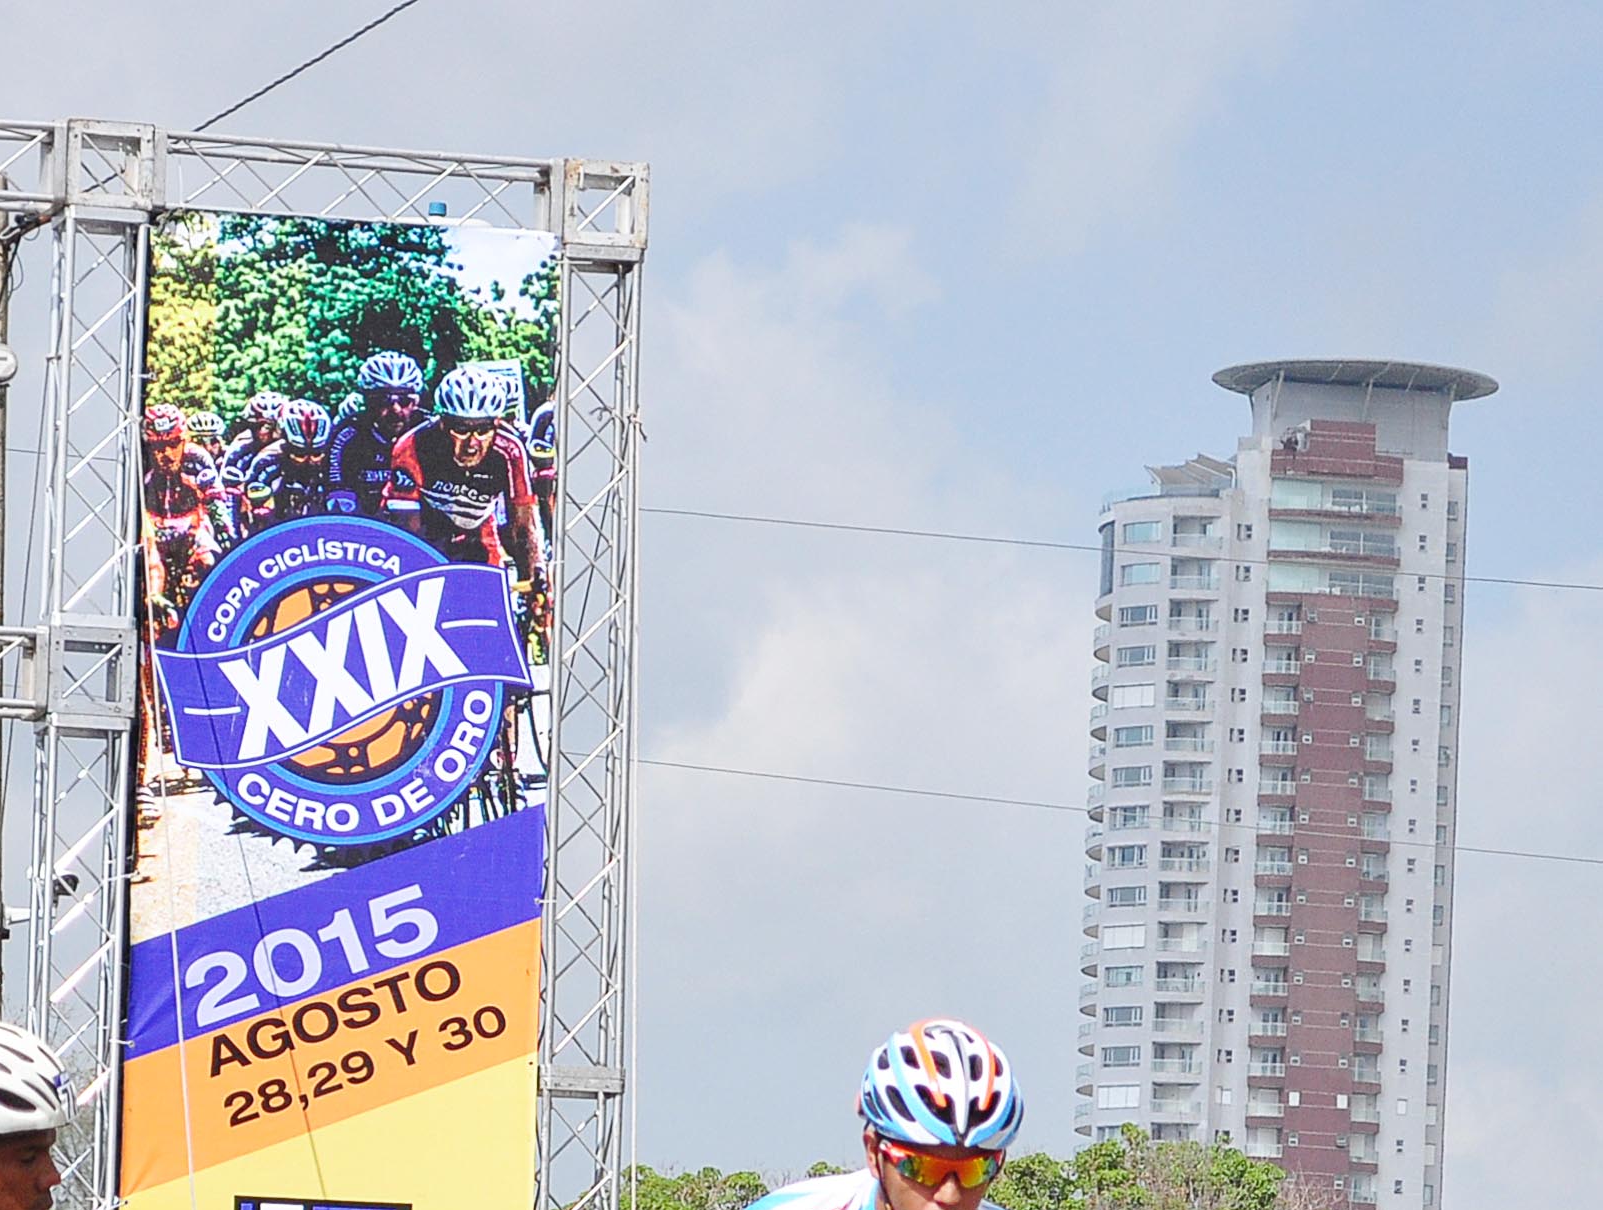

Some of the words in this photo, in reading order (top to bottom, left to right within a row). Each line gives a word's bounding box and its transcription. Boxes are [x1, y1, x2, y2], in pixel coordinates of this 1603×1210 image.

[207, 576, 260, 643] COPA
[258, 538, 402, 576] CICLÍSTICA
[218, 576, 469, 760] XXIX
[237, 771, 360, 832] CERO
[374, 777, 434, 827] DE
[433, 690, 493, 784] ORO
[184, 883, 440, 1028] 2015
[209, 960, 461, 1078] AGOSTO
[223, 1050, 375, 1128] 28,29
[385, 1030, 419, 1067] Y
[437, 1005, 507, 1052] 30
